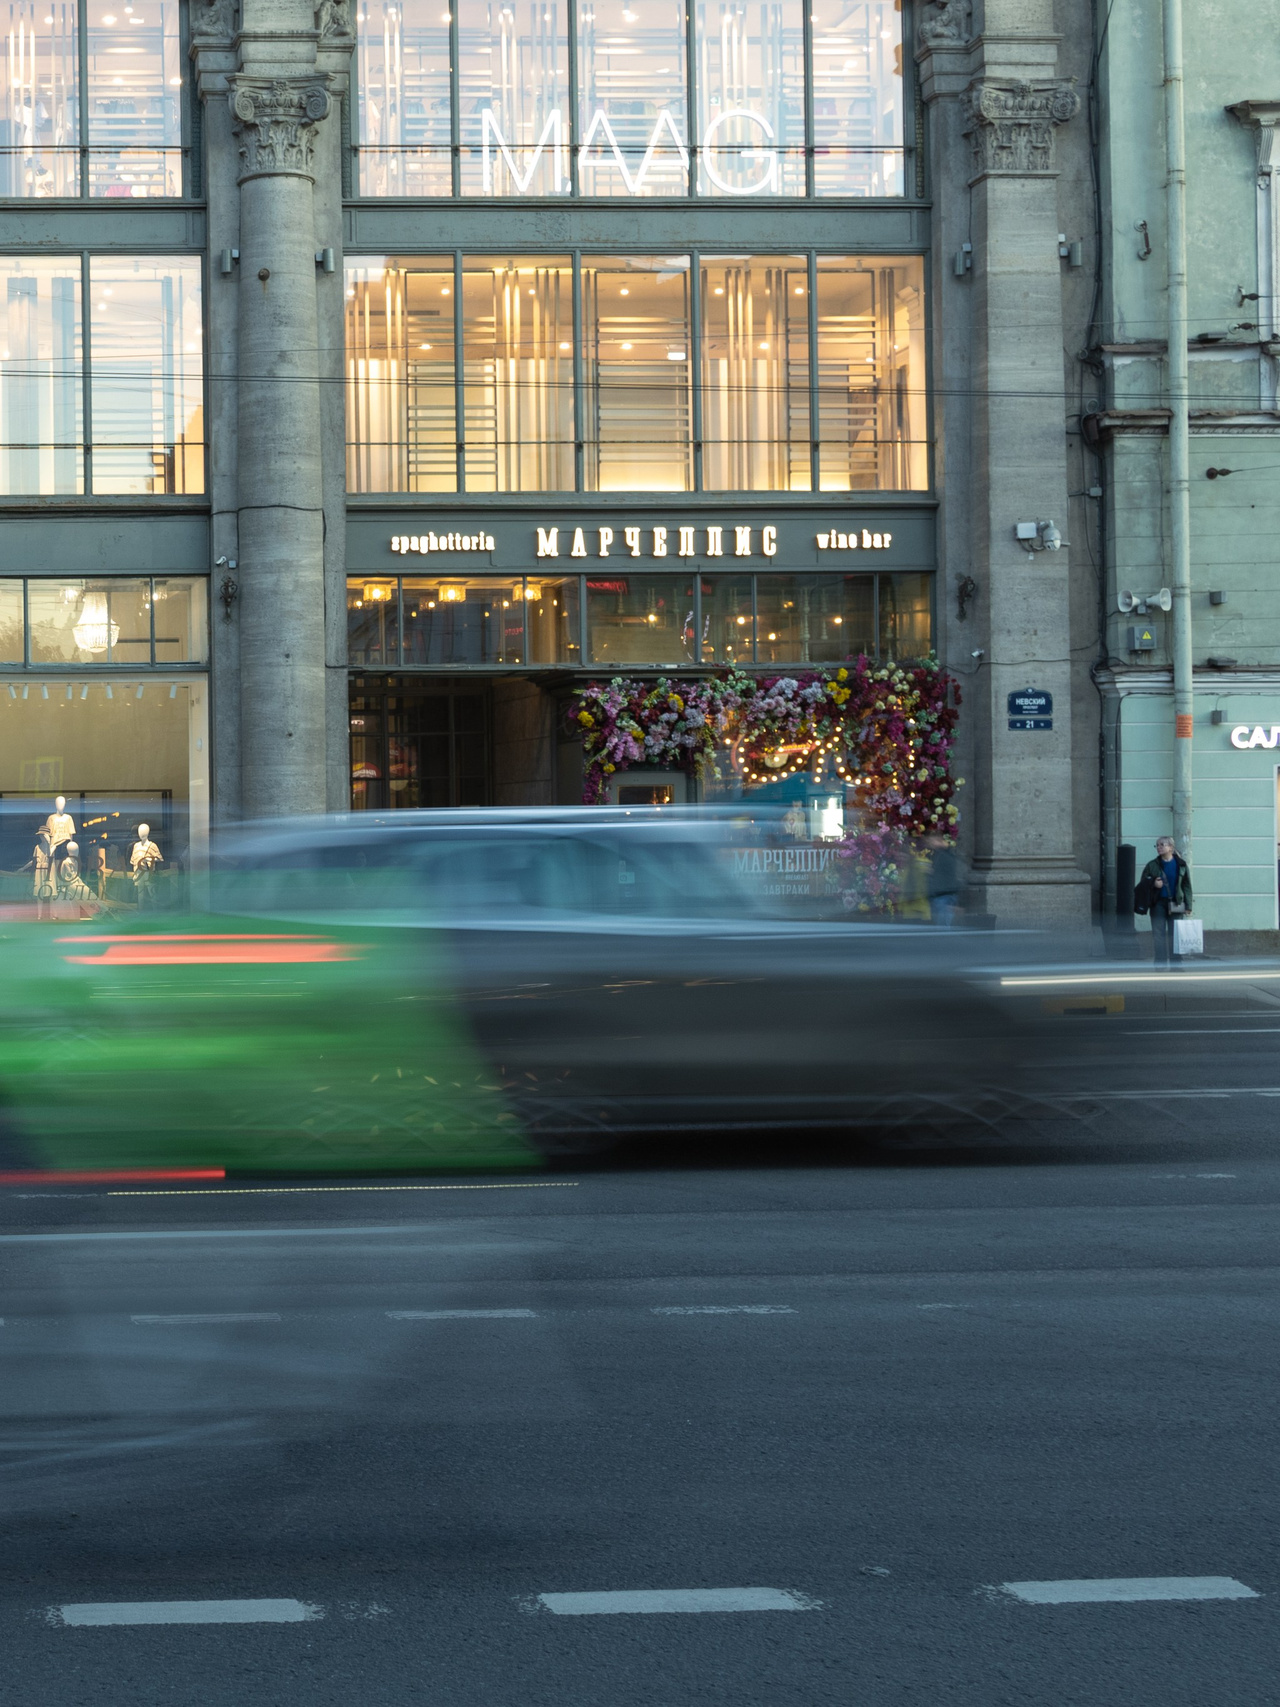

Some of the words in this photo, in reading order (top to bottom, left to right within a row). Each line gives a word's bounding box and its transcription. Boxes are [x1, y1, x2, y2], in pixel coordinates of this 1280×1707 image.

[481, 108, 777, 194] MAAG
[536, 526, 777, 557] МАРЧЕЛЛИС
[816, 529, 858, 549] wine
[862, 529, 892, 549] bar
[1015, 696, 1046, 706] НЕВСКИЙ
[1025, 720, 1034, 729] 21
[763, 884, 810, 895] ЗАВТРАКИ
